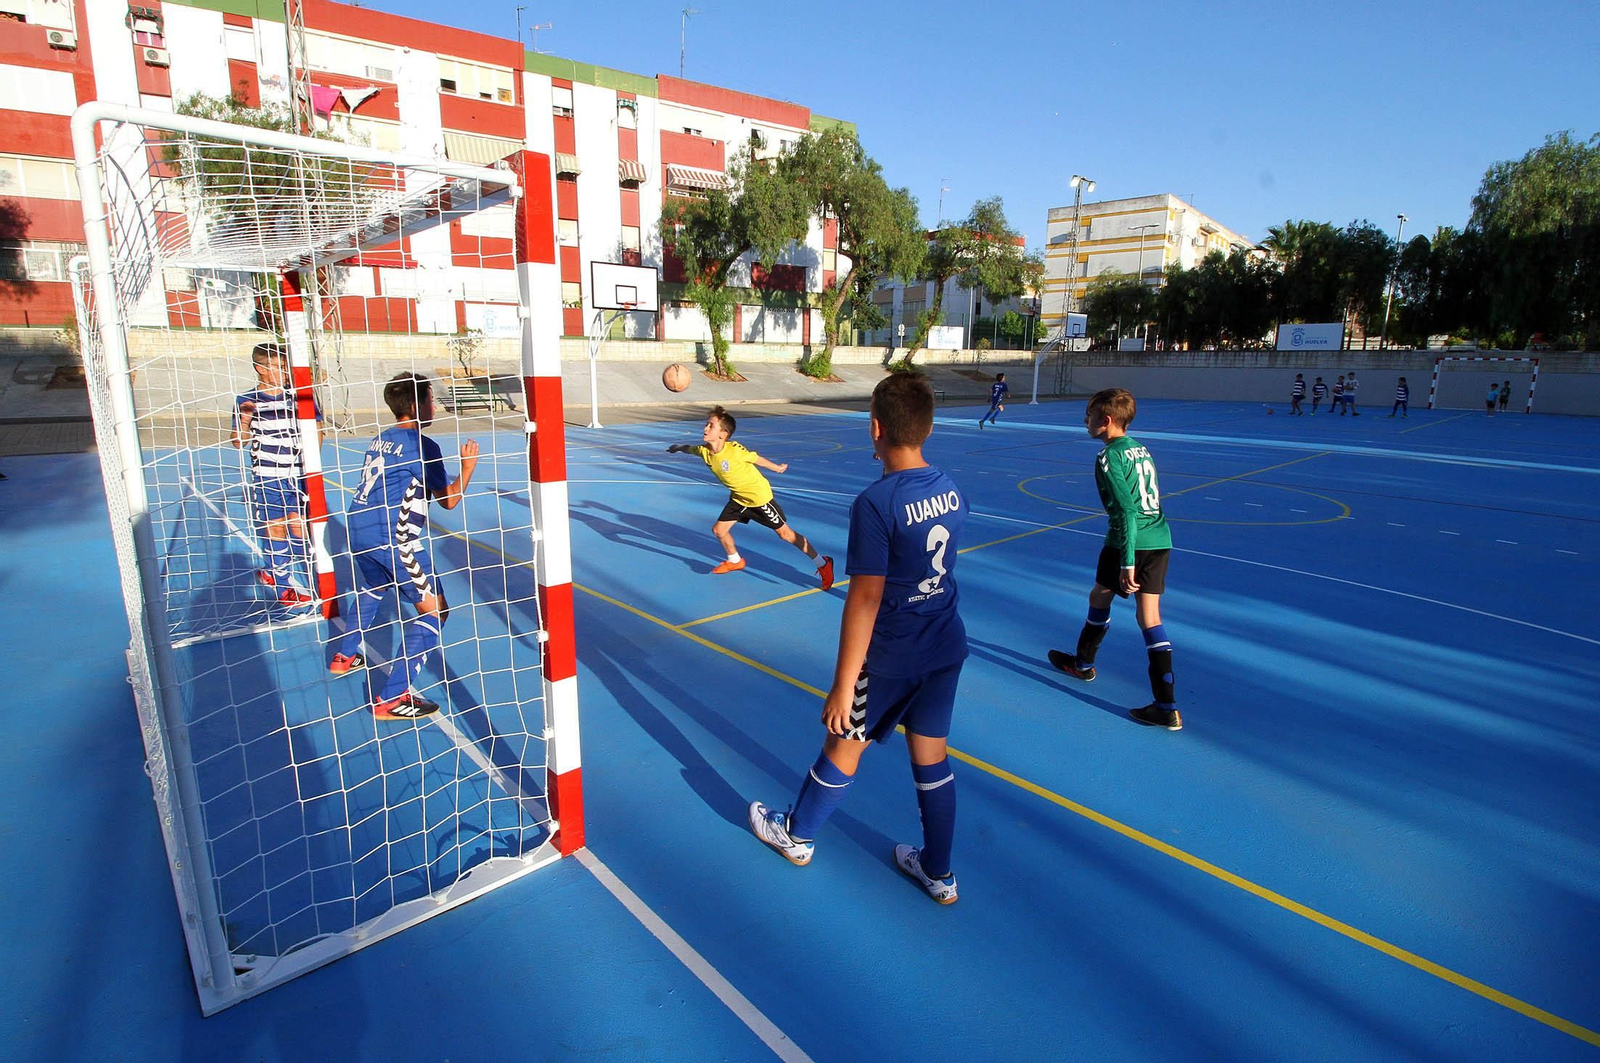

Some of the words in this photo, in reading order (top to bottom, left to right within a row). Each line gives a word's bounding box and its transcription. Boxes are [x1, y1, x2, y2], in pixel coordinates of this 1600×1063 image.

[368, 440, 394, 454] ANUEL
[1135, 460, 1160, 510] 13
[905, 490, 959, 526] JUANJO
